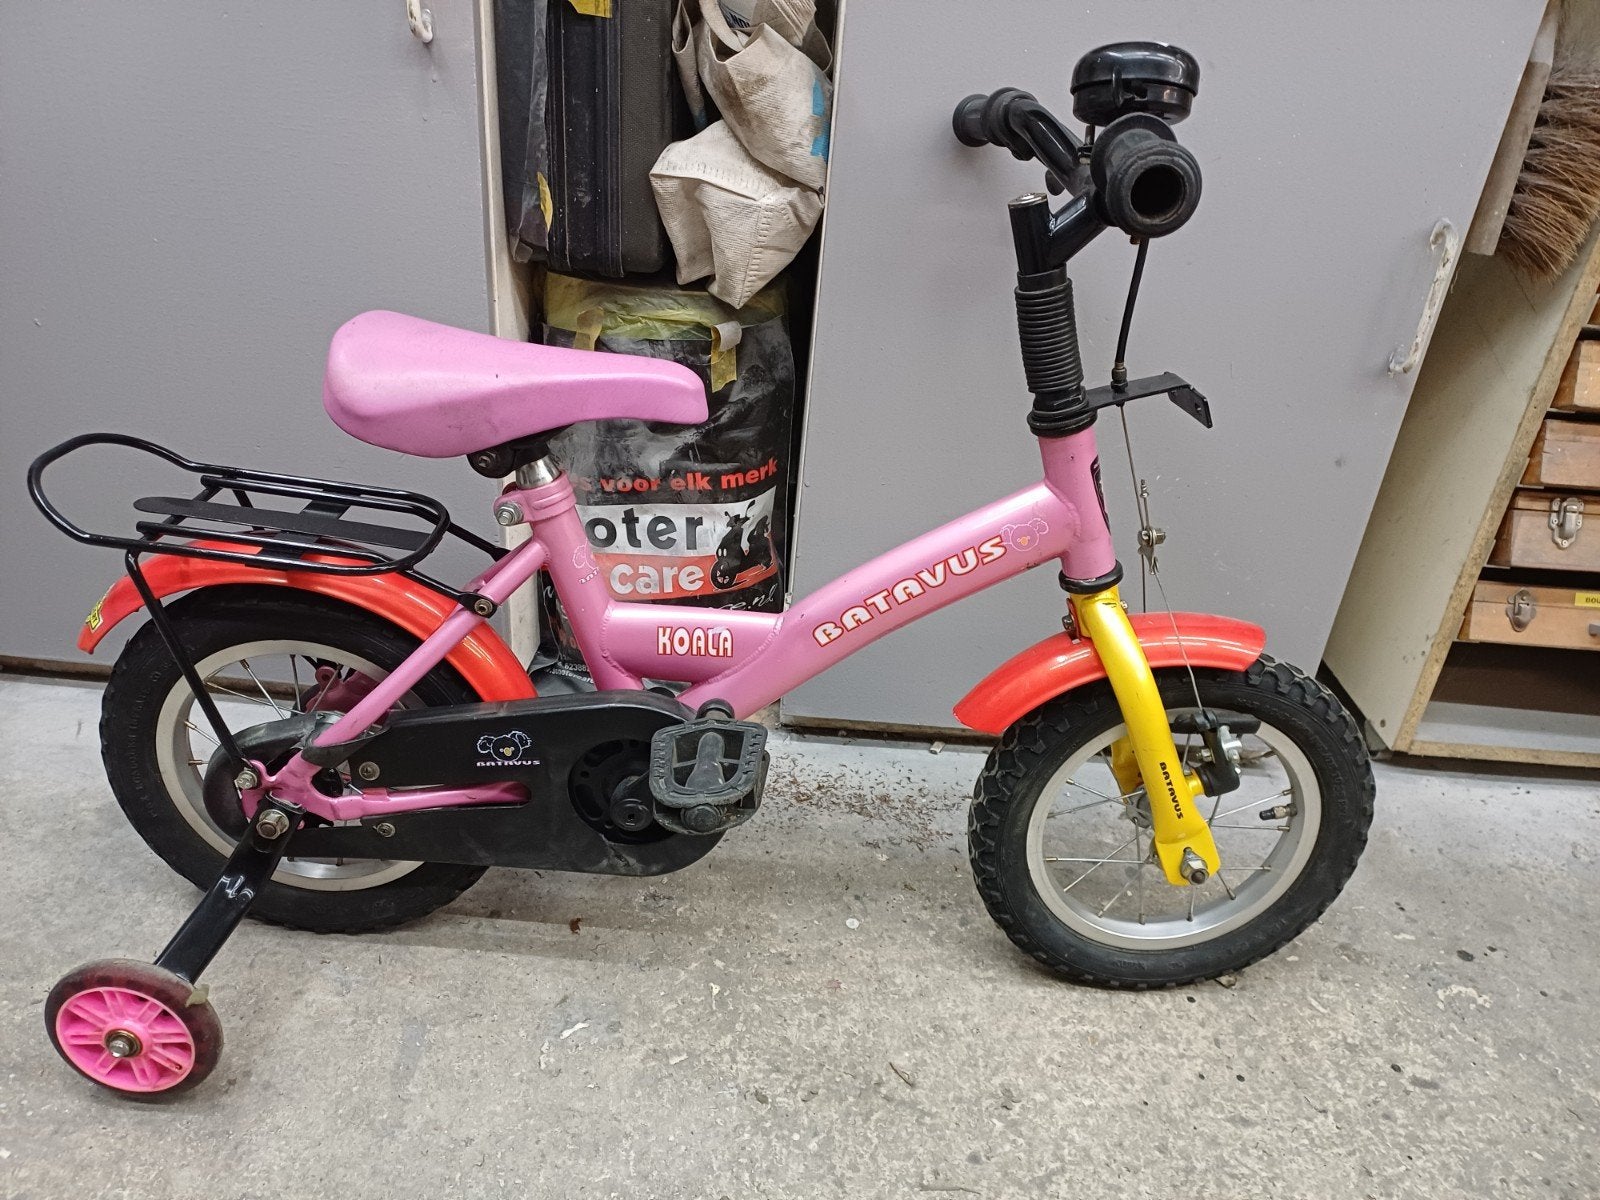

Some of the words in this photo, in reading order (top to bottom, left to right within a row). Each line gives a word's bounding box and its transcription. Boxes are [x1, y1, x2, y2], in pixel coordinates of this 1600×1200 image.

[600, 476, 660, 492] voor
[670, 472, 713, 491] elk
[720, 457, 778, 490] merk
[609, 563, 705, 594] care
[811, 534, 1007, 648] BATAVUS
[656, 625, 734, 658] KOALA
[476, 759, 541, 767] BATAVUS
[1159, 761, 1184, 820] BATAVUS
